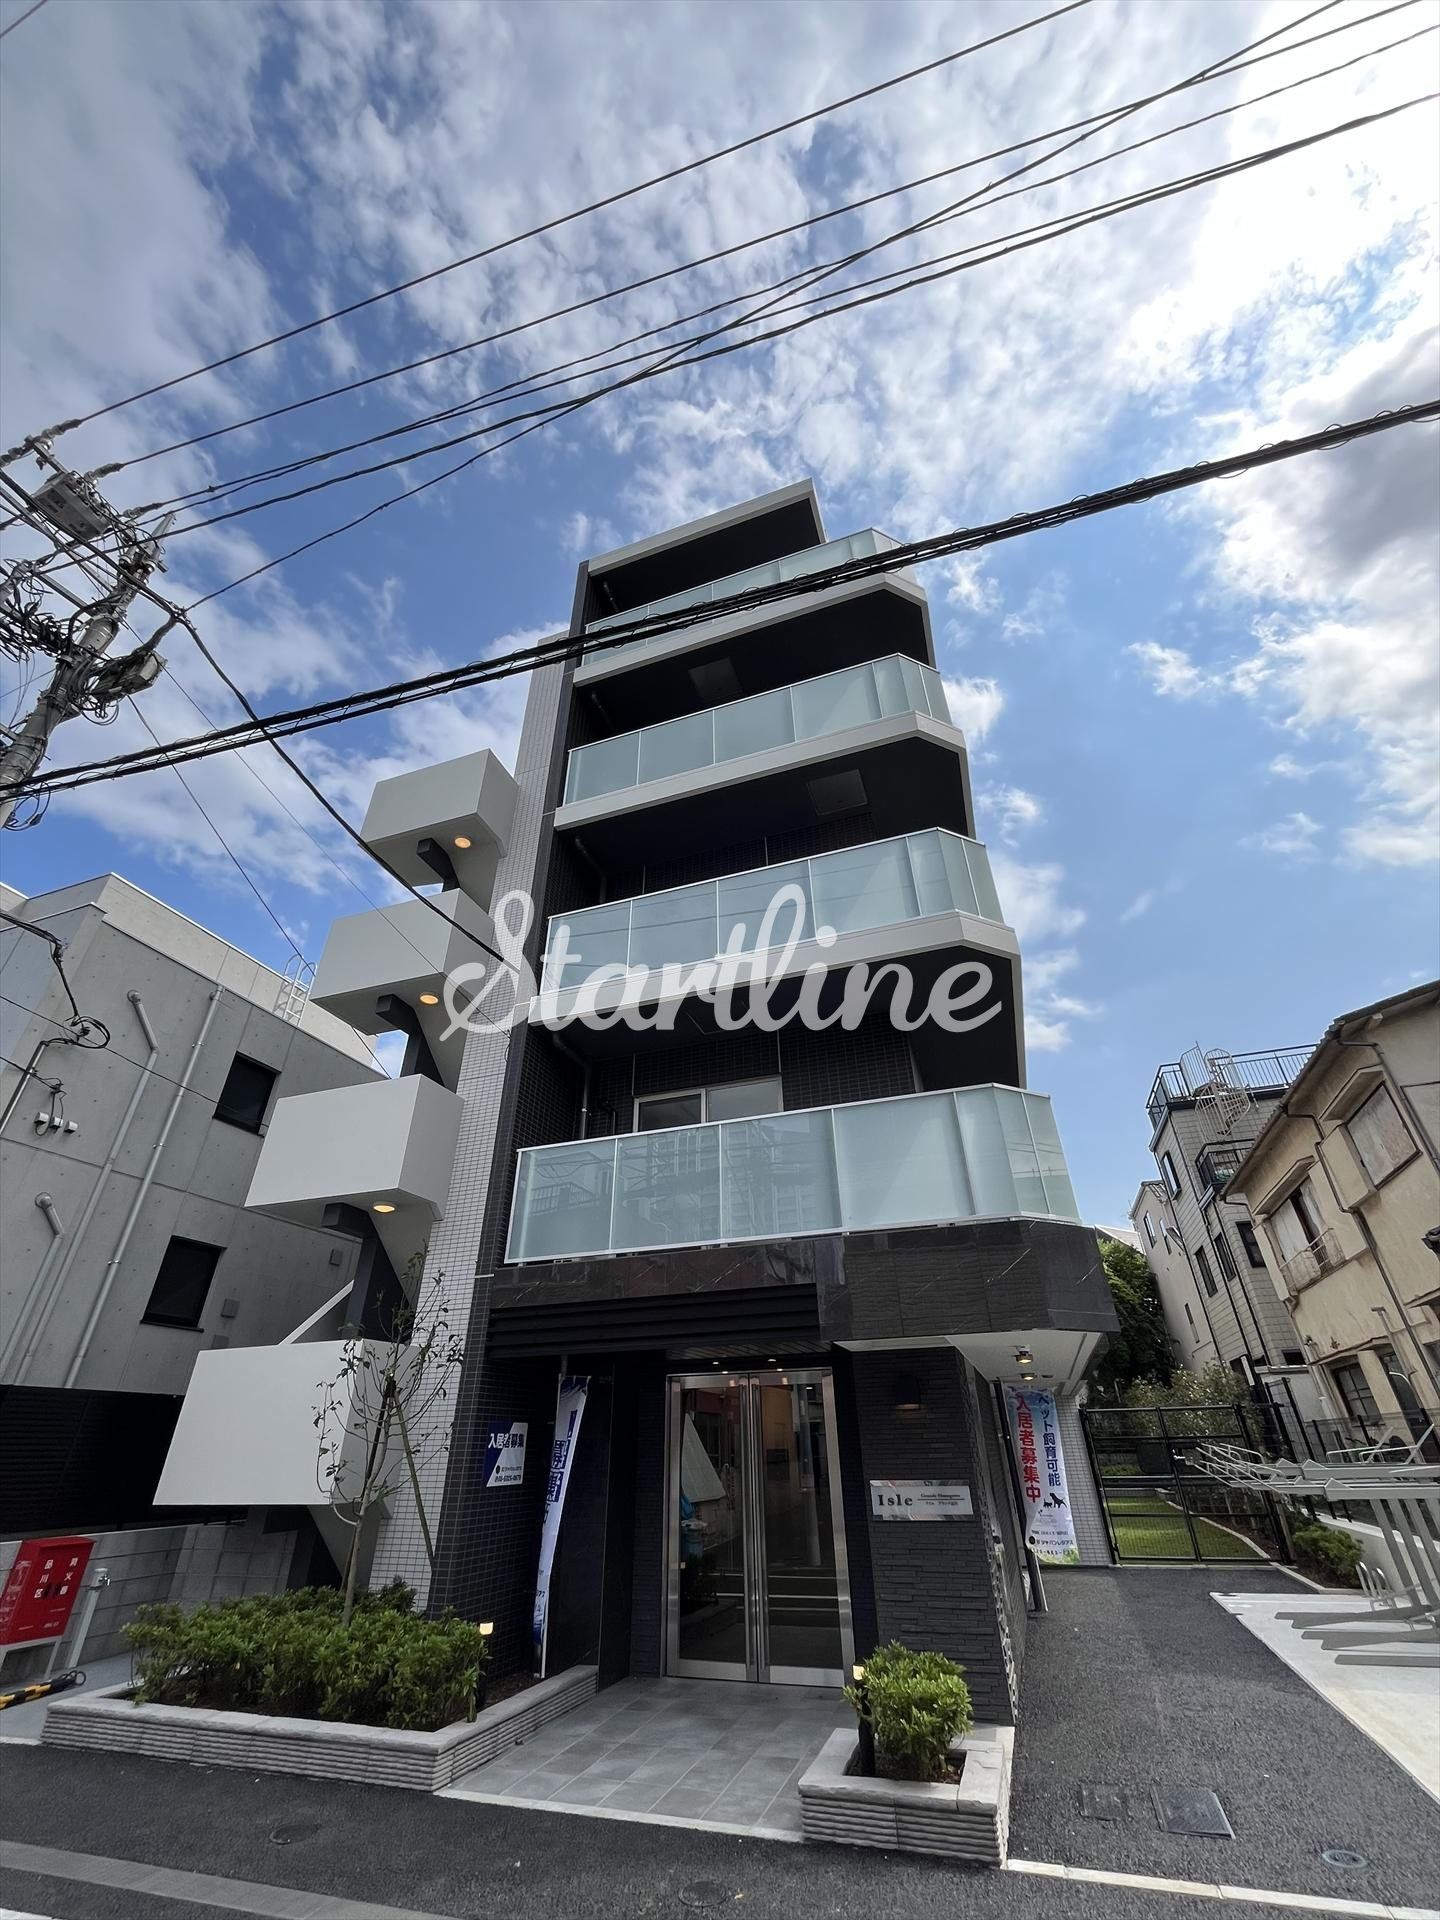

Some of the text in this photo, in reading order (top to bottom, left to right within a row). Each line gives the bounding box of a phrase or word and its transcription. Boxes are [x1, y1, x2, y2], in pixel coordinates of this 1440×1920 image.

[488, 1432, 525, 1449] 入居者募集
[1016, 1391, 1041, 1503] 入居者募集中
[1038, 1394, 1061, 1487] ペット飼育可能
[877, 1494, 913, 1506] Isle
[34, 1559, 54, 1599] 品川区
